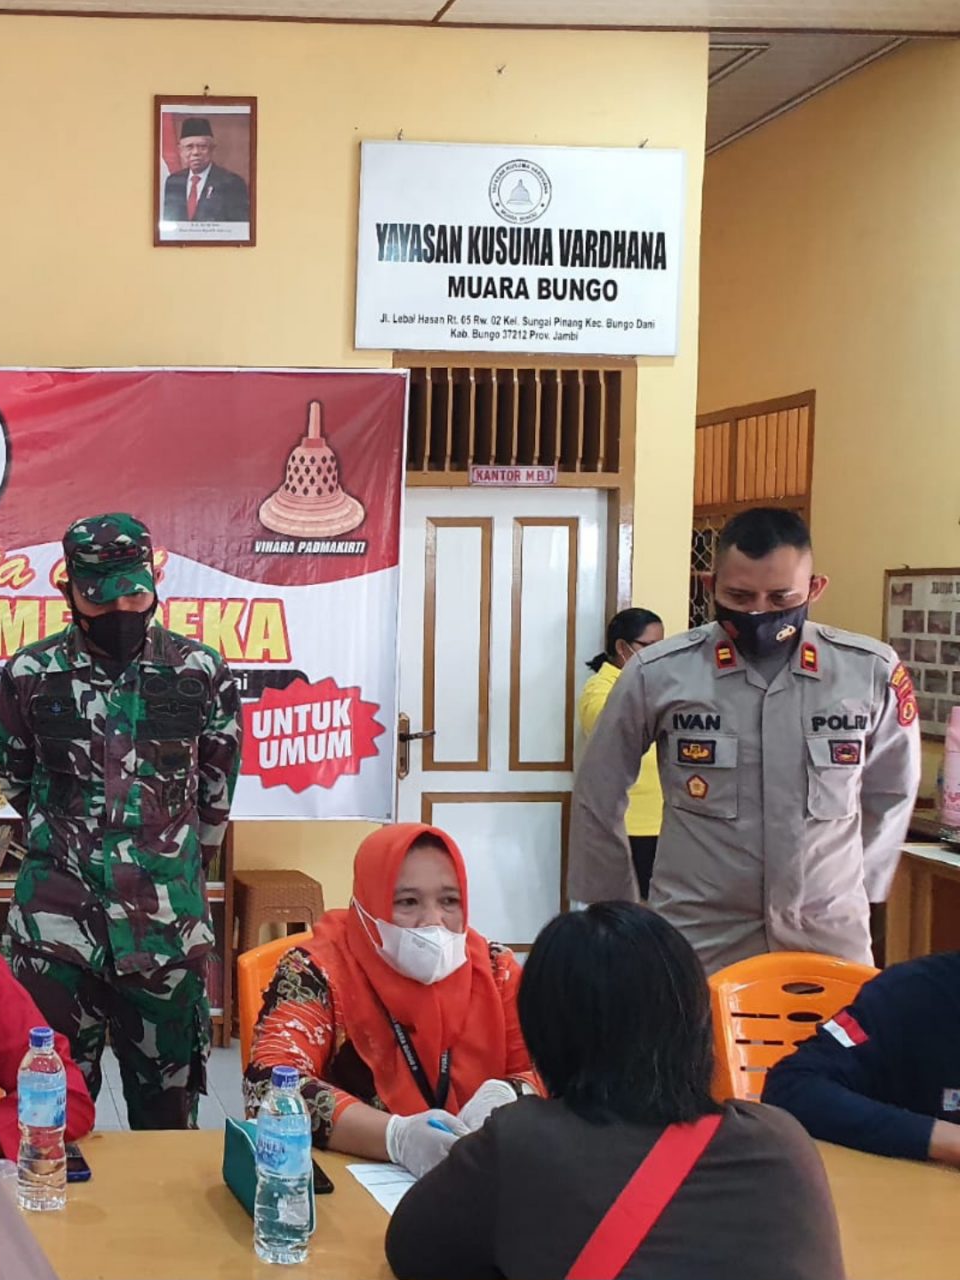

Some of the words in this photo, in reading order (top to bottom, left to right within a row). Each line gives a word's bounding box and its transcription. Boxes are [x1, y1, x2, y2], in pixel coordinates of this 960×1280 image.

[375, 223, 463, 264] YAYASAN
[467, 225, 554, 267] KUSUMA
[558, 228, 667, 270] VARDHANA
[448, 275, 530, 300] MUARA
[537, 278, 618, 302] BUNGO
[418, 314, 445, 325] Hasan
[490, 316, 502, 326] 02
[522, 316, 552, 329] Sungai
[554, 317, 583, 329] Pinang
[606, 318, 634, 330] Bungo
[472, 329, 500, 342] Bungo
[553, 330, 579, 342] Jambi
[476, 469, 521, 482] KANTOR
[254, 540, 295, 554] VIHARA
[252, 697, 353, 740] UNTUK
[672, 712, 721, 731] IVAN
[811, 713, 869, 732] POLRI
[258, 729, 353, 770] UMUM
